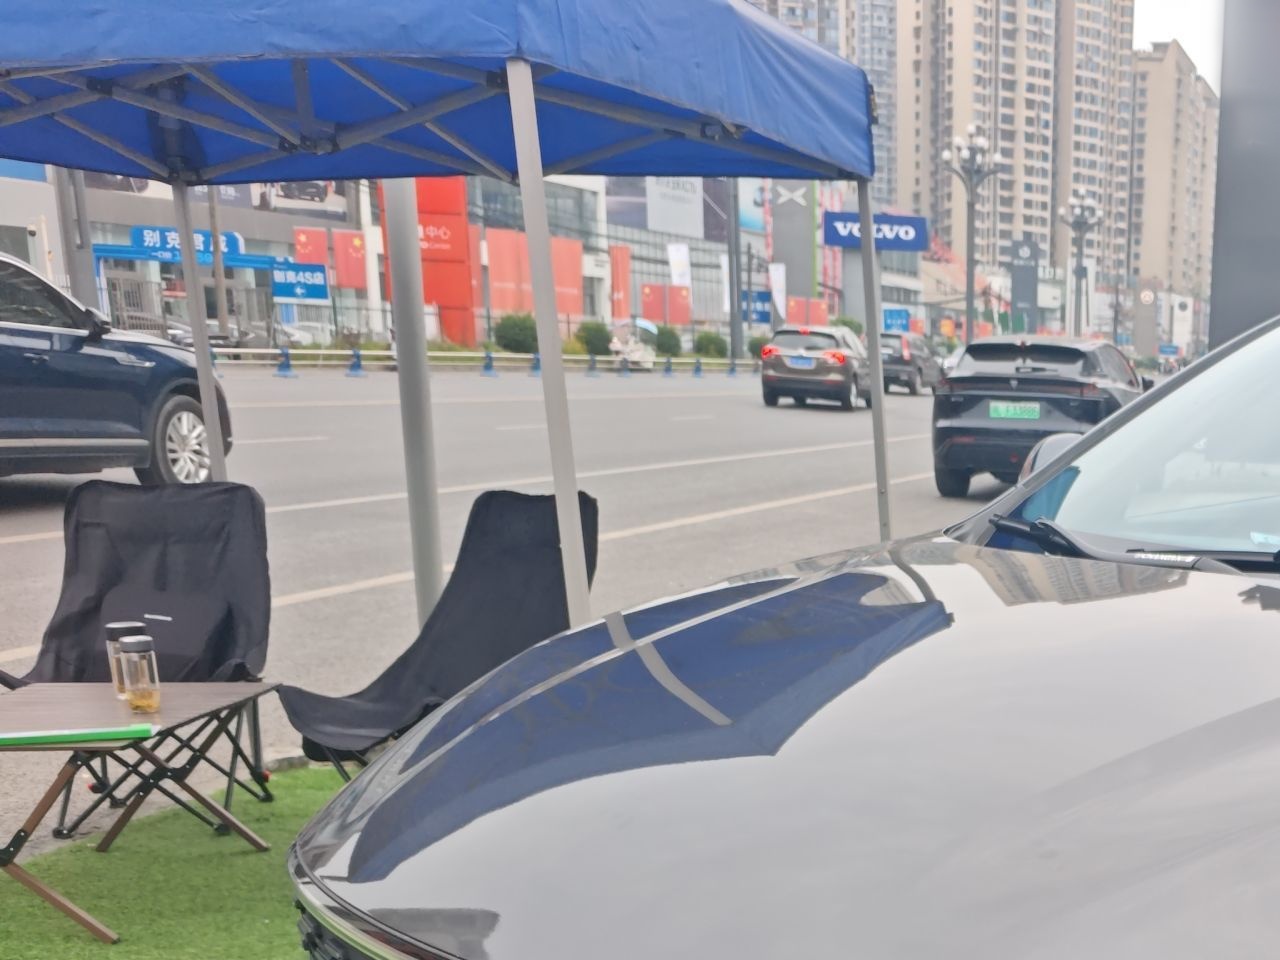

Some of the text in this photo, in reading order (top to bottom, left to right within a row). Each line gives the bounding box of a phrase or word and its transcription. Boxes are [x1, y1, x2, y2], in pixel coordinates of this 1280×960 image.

[832, 220, 917, 241] VOLVO
[273, 269, 325, 285] 别克4S店
